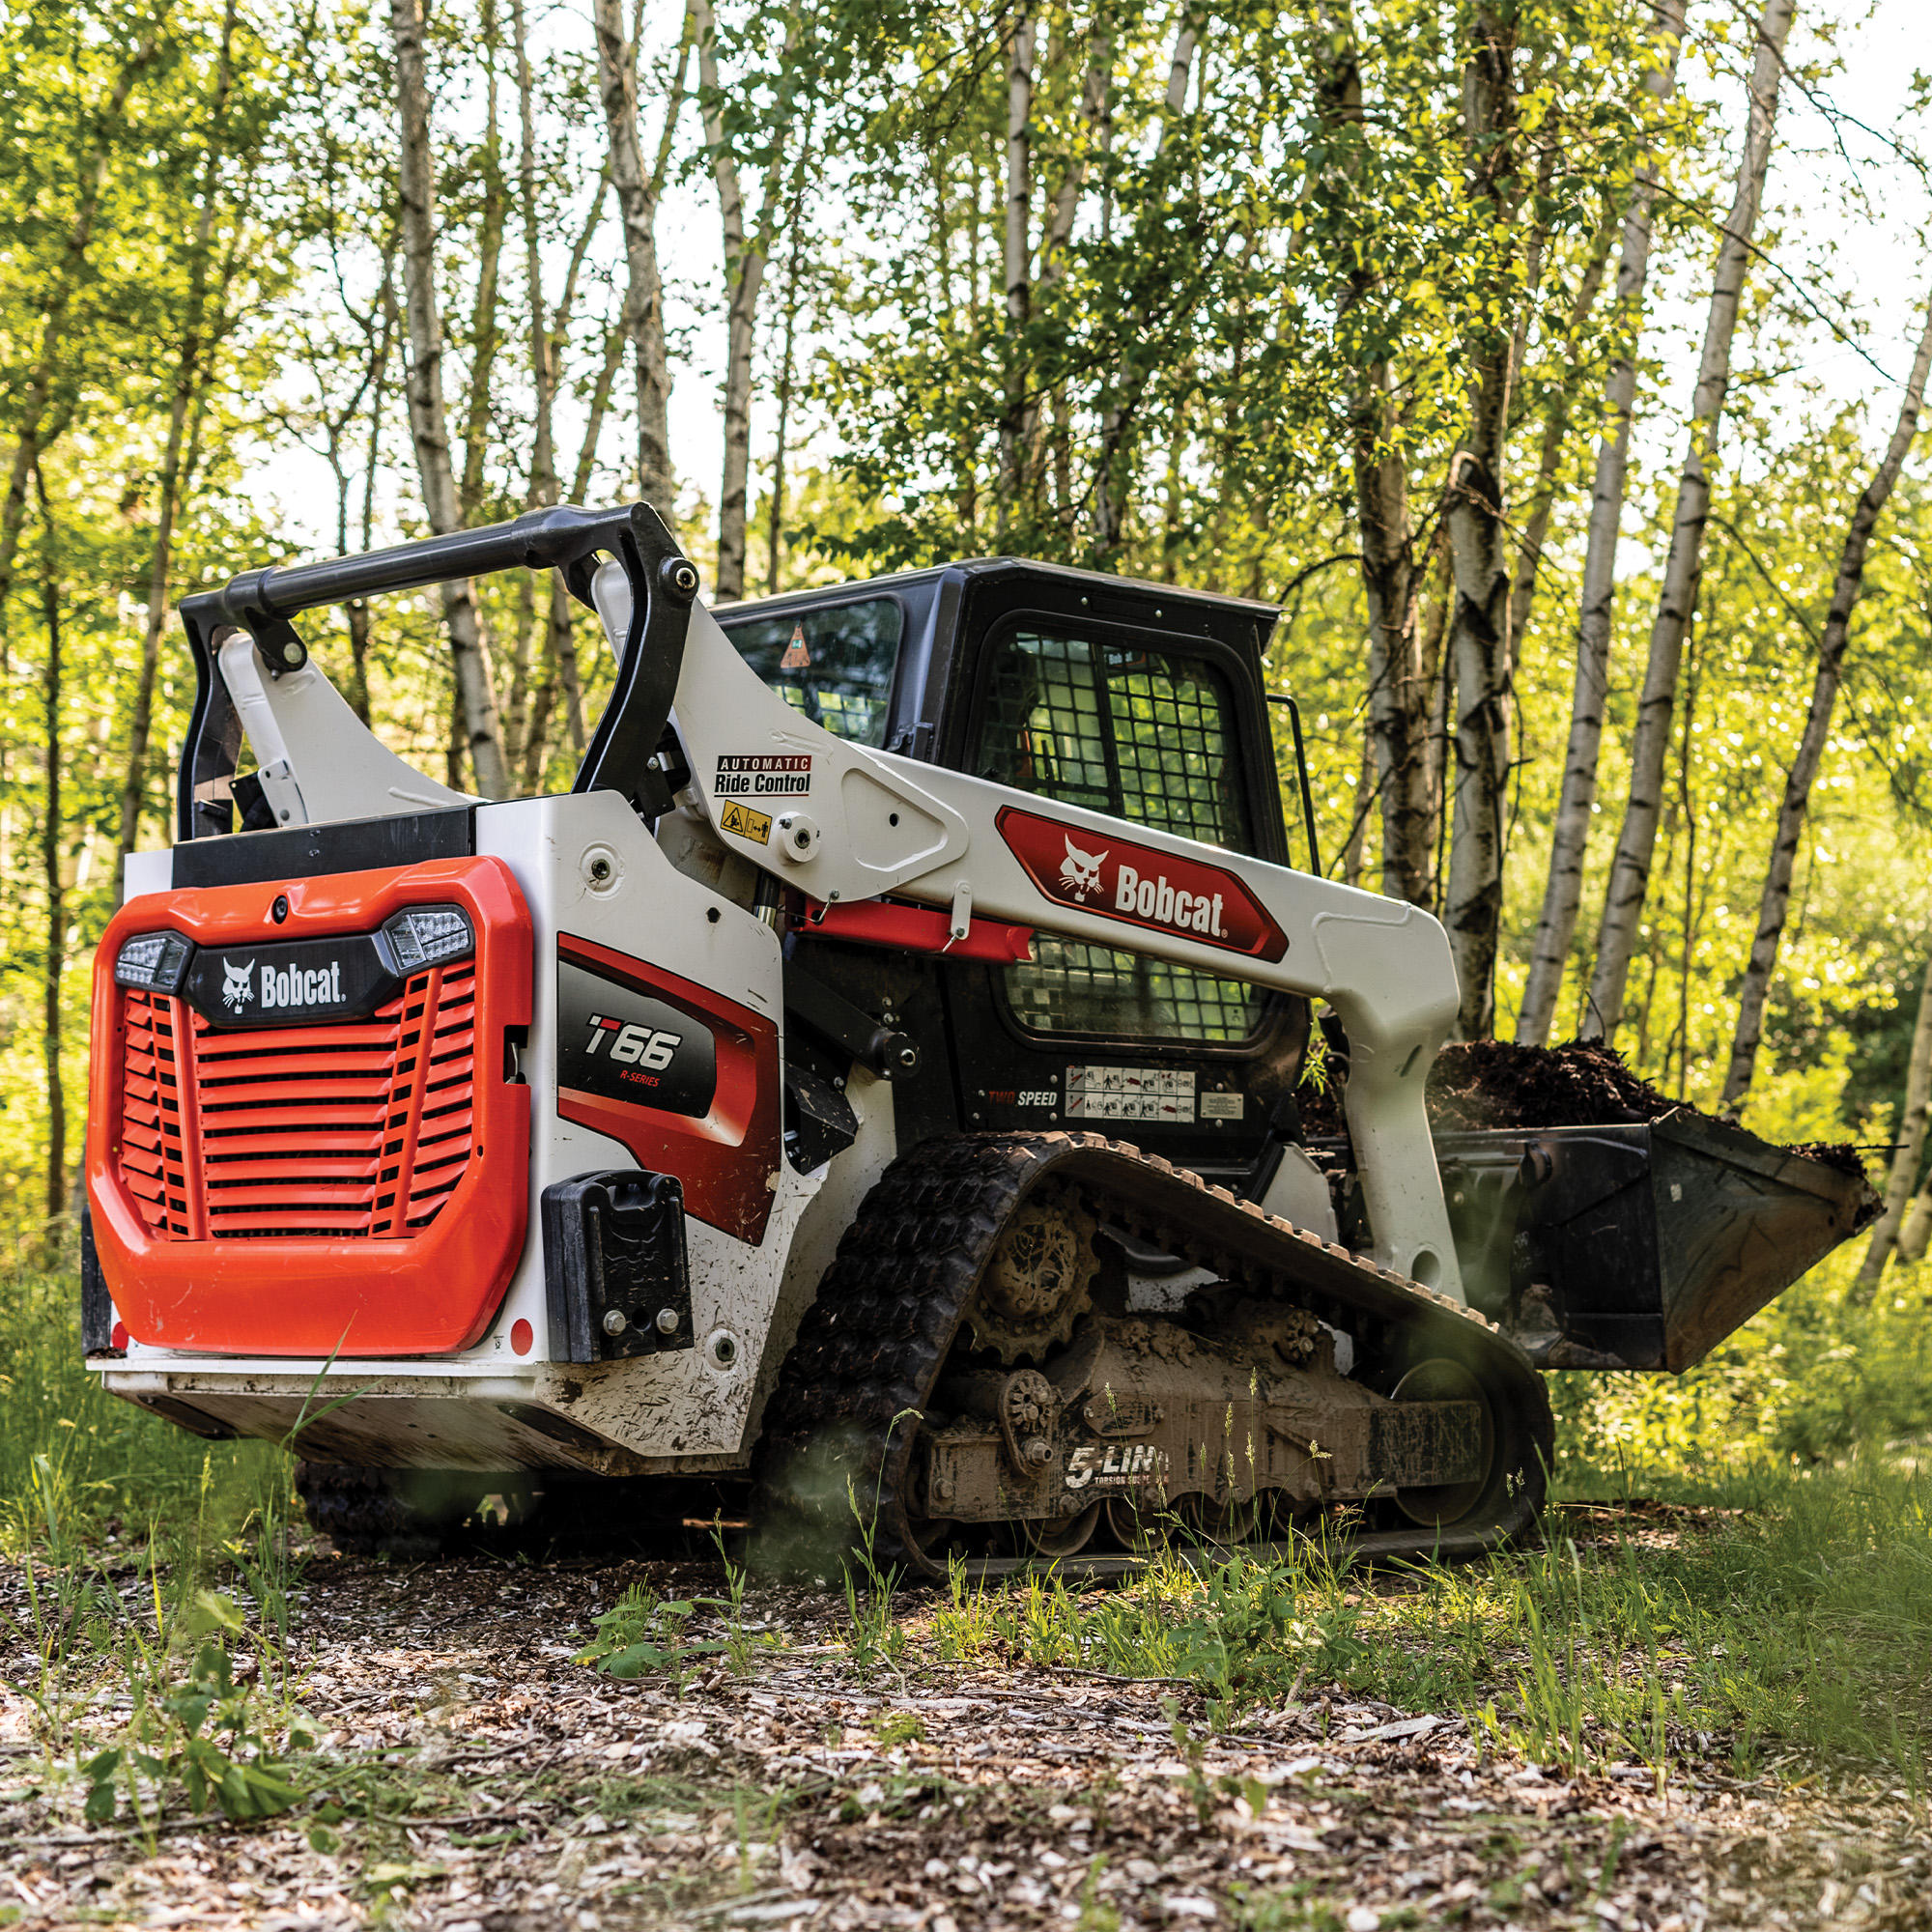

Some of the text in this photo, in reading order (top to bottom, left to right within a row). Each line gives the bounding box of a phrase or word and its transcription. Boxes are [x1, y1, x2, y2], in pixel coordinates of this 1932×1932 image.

[1108, 652, 1132, 666] Bobat
[720, 757, 810, 771] AUTOMATIC
[714, 773, 811, 793] Ride Control
[1115, 864, 1224, 938] Bobcat
[260, 960, 341, 1009] Bobcat
[584, 1014, 682, 1071] T66
[620, 1069, 661, 1088] R-SERIES
[988, 1091, 1058, 1106] TWO SPEED
